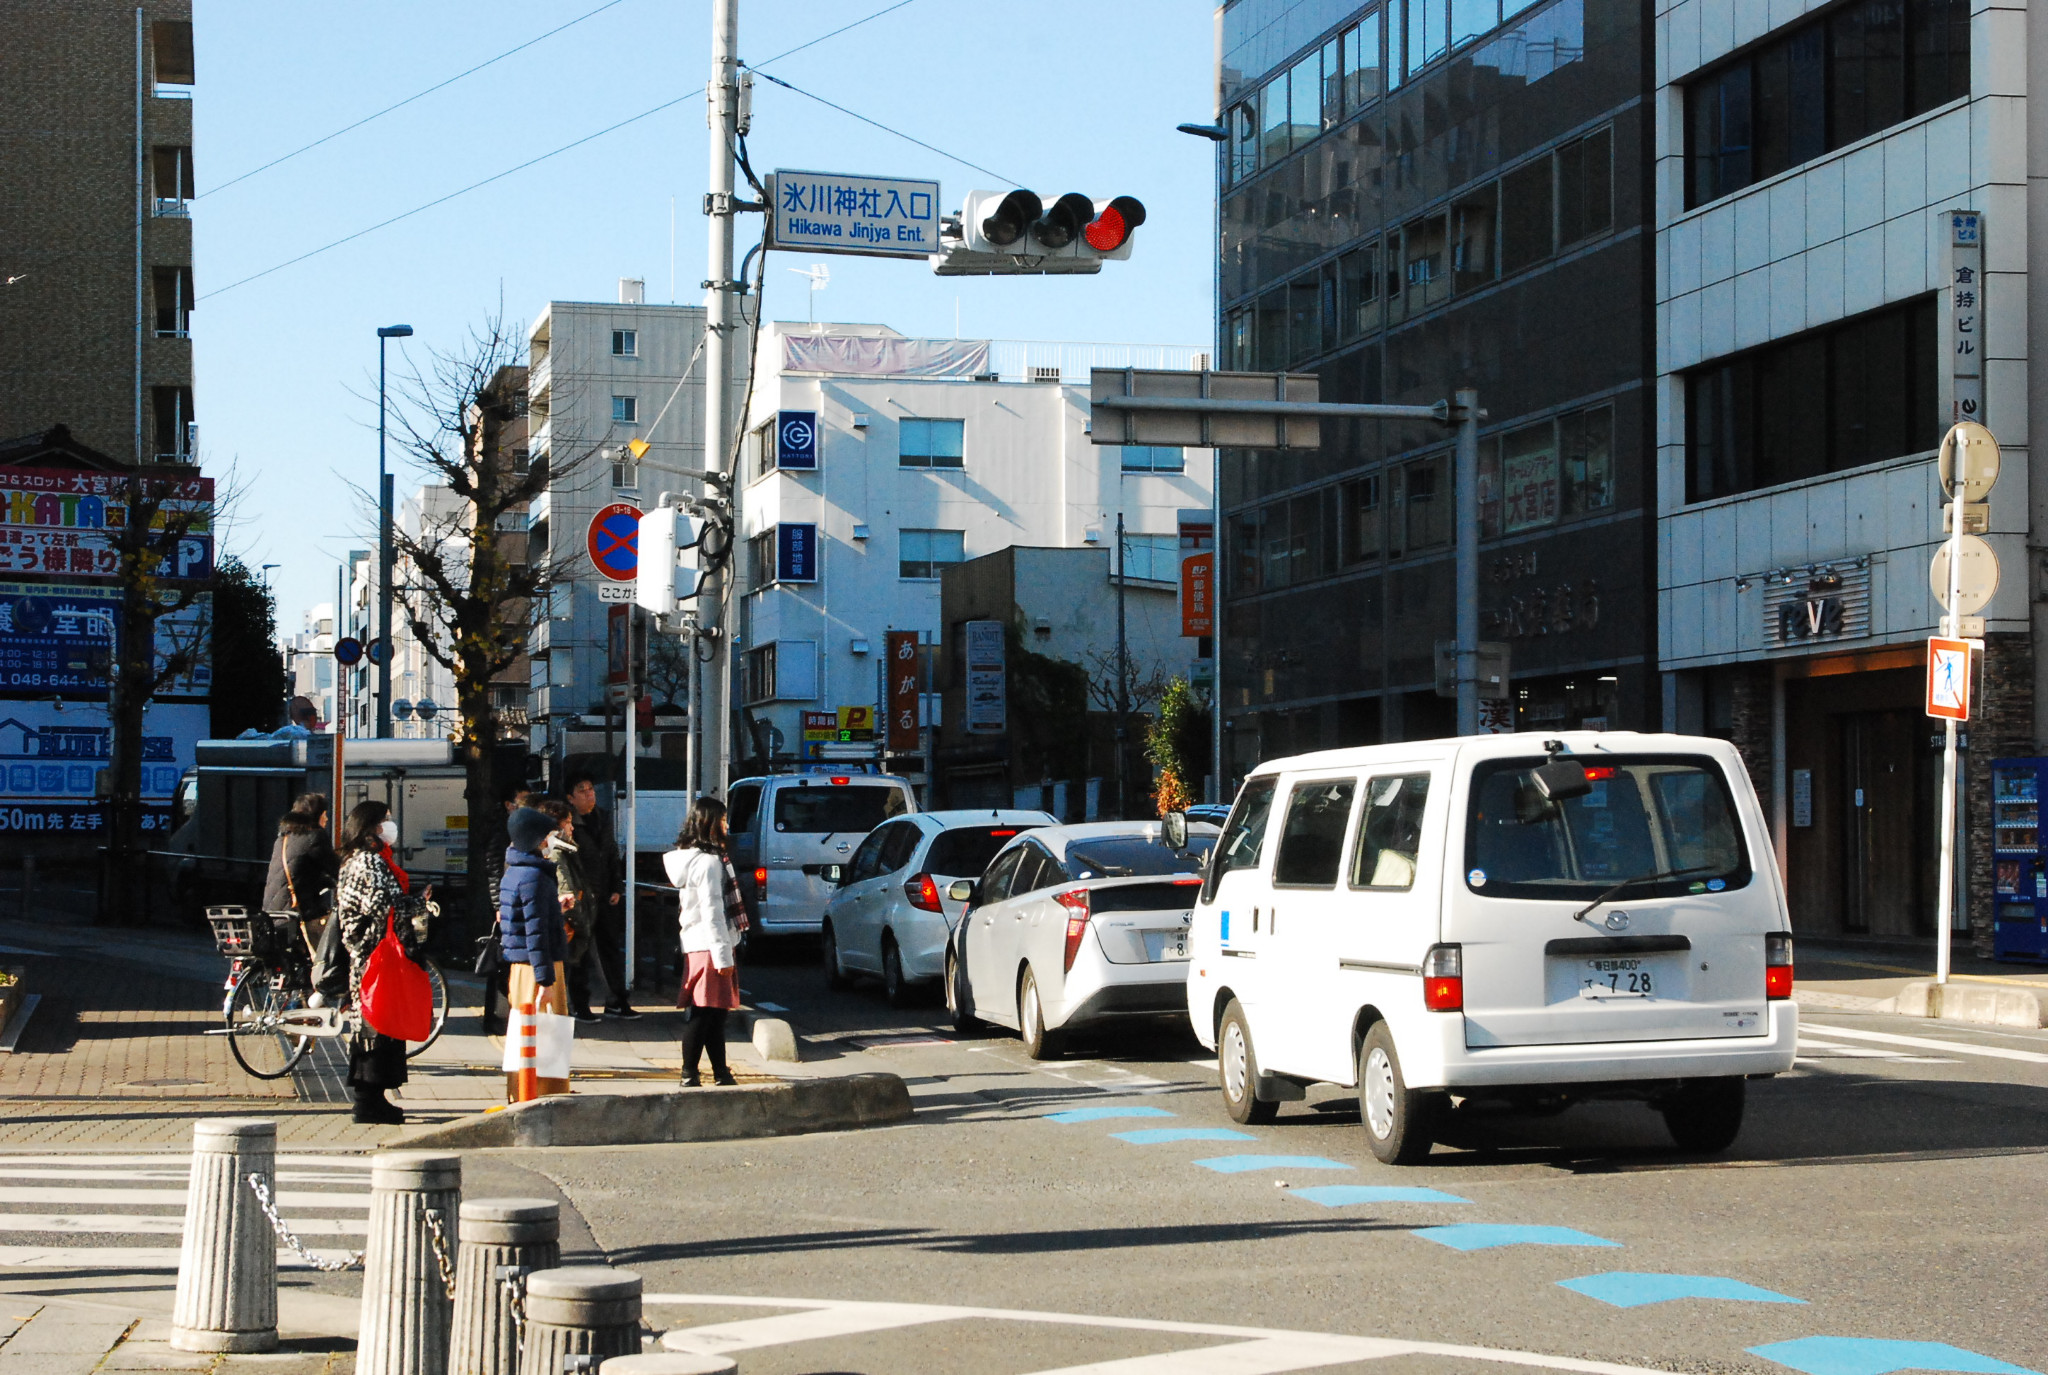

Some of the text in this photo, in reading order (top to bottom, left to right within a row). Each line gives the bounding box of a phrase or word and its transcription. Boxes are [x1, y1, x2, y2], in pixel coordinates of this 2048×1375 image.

[783, 182, 931, 220] 氷川神社入口
[789, 218, 925, 242] Hikawa Jinjya Ent.
[1956, 266, 1975, 355] 倉持ビル
[1193, 579, 1205, 613] 郵便局
[898, 639, 916, 730] あがる
[38, 735, 96, 756] BLUE
[839, 730, 851, 741] 空
